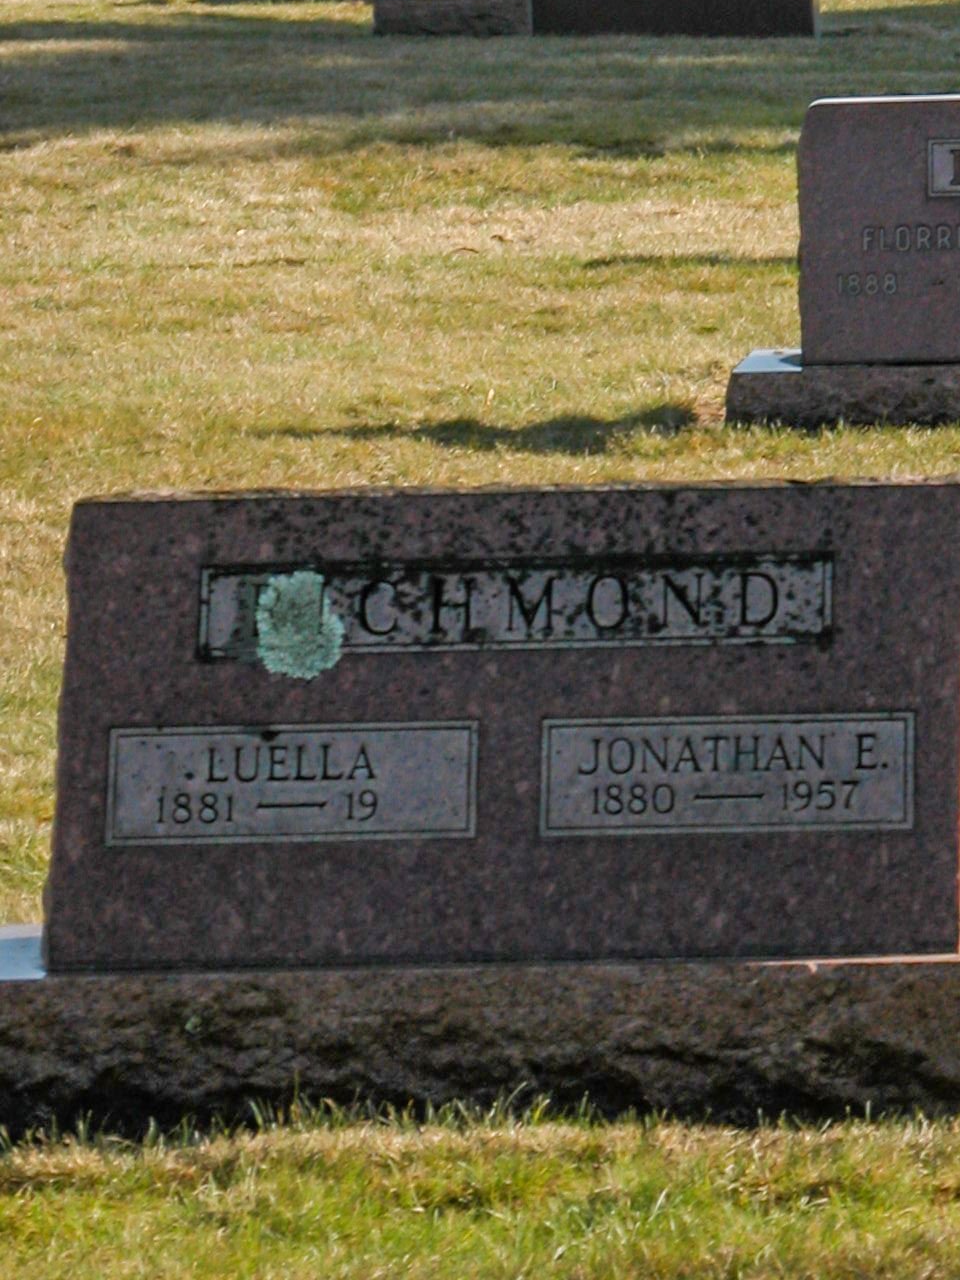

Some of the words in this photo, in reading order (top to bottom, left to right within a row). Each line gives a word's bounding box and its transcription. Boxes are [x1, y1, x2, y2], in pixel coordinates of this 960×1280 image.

[835, 271, 898, 296] 1888
[205, 743, 377, 784] LUELLA
[577, 732, 826, 776] JONATHAN
[855, 732, 889, 770] E.
[155, 791, 235, 824] 1881
[346, 789, 379, 821] 19
[590, 782, 676, 816] 1880
[782, 779, 861, 813] 1957
